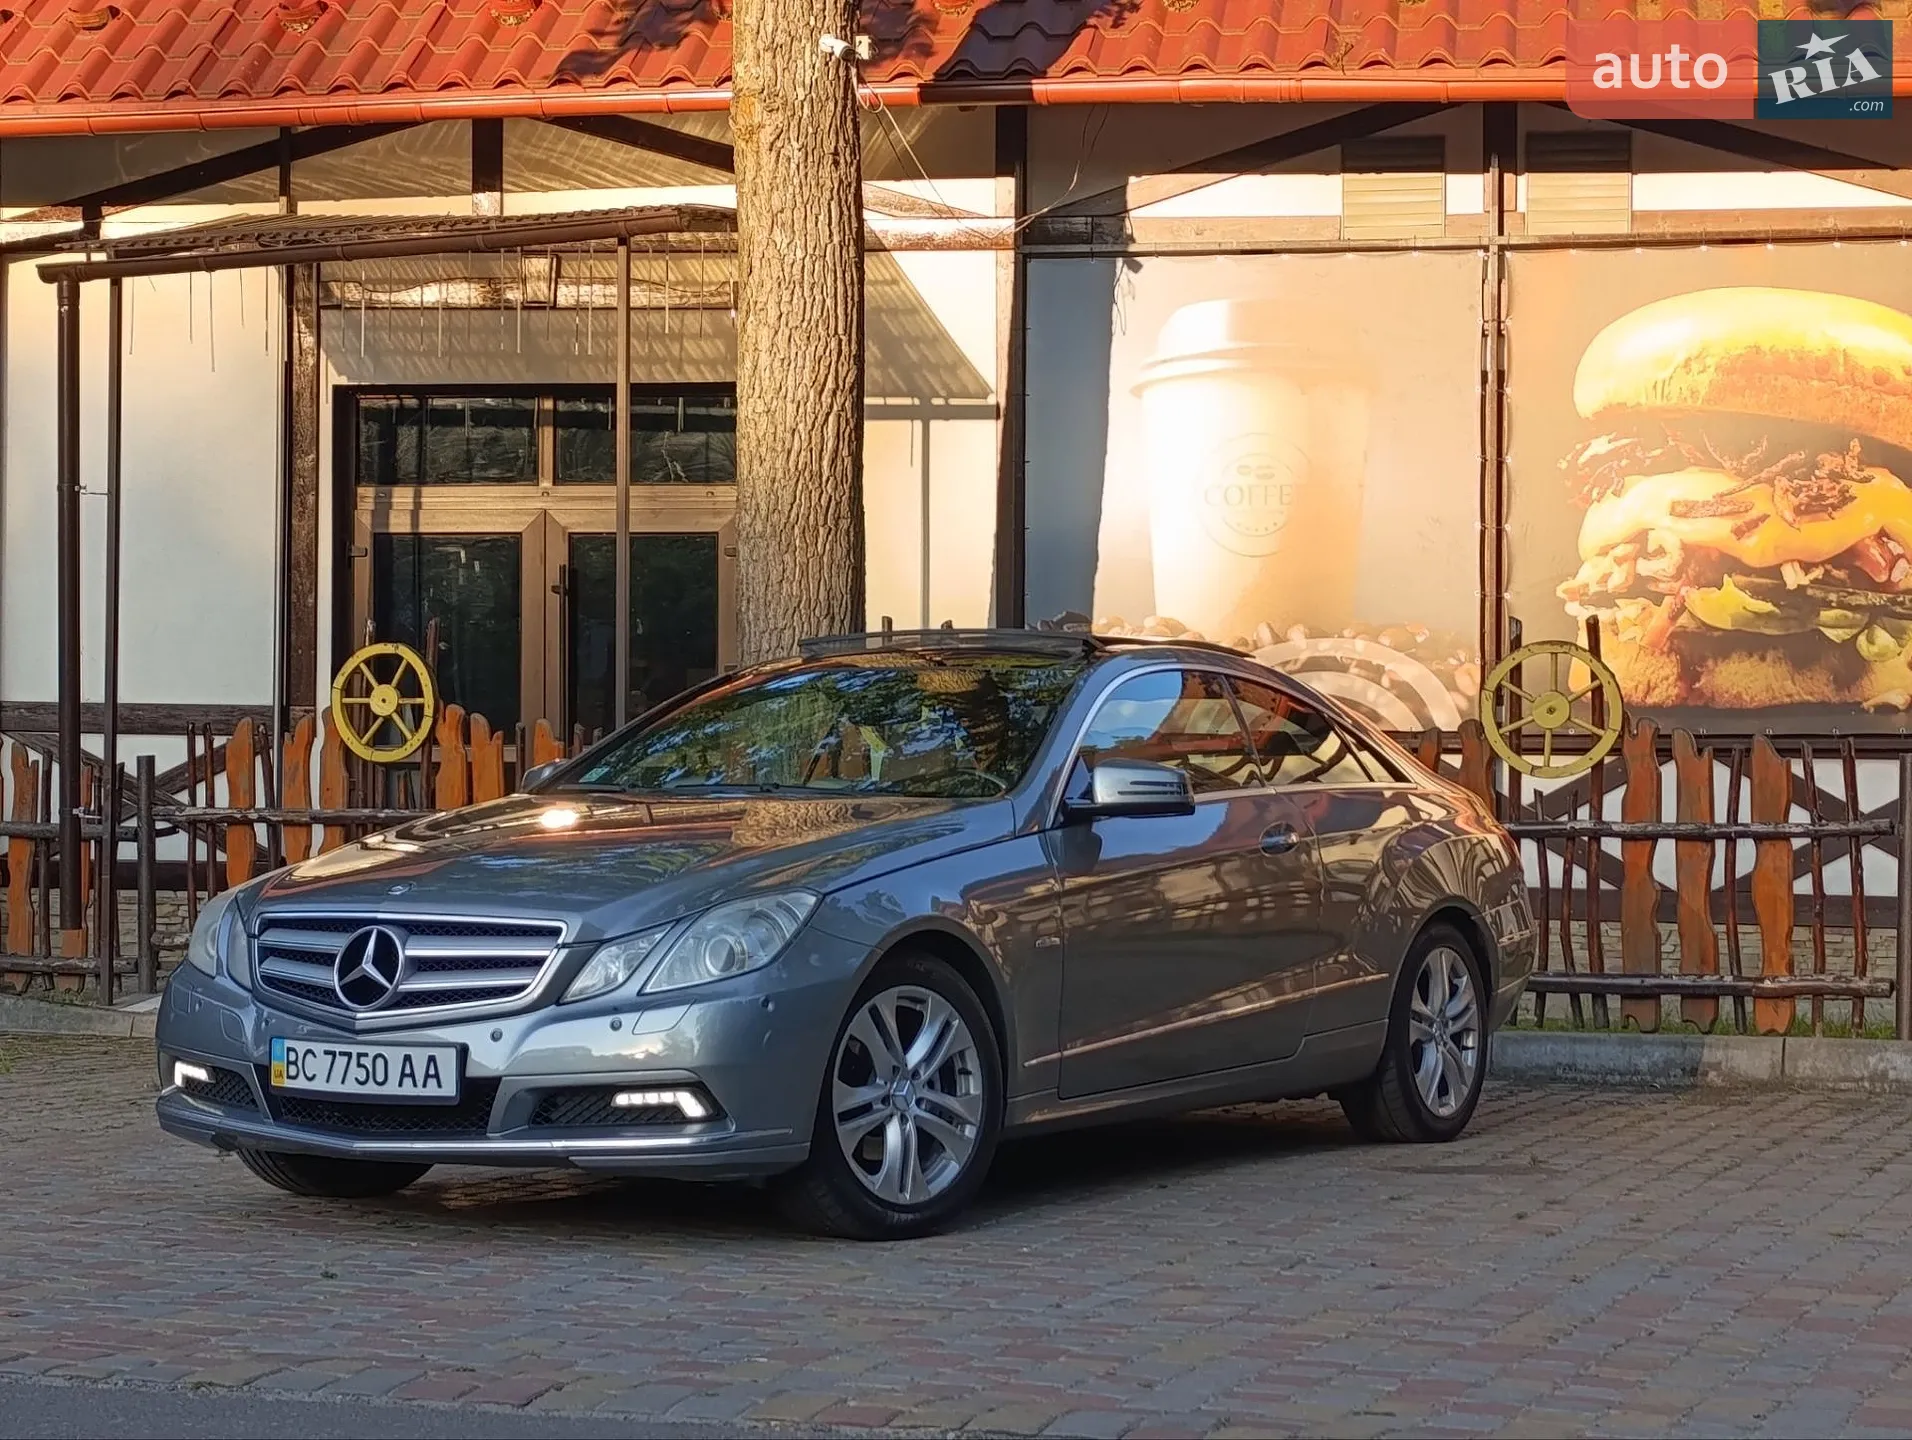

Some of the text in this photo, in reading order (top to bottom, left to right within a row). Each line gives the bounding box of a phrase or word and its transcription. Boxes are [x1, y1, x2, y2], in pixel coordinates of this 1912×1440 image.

[274, 1067, 284, 1080] UA
[286, 1046, 443, 1089] BC 7750 AA
